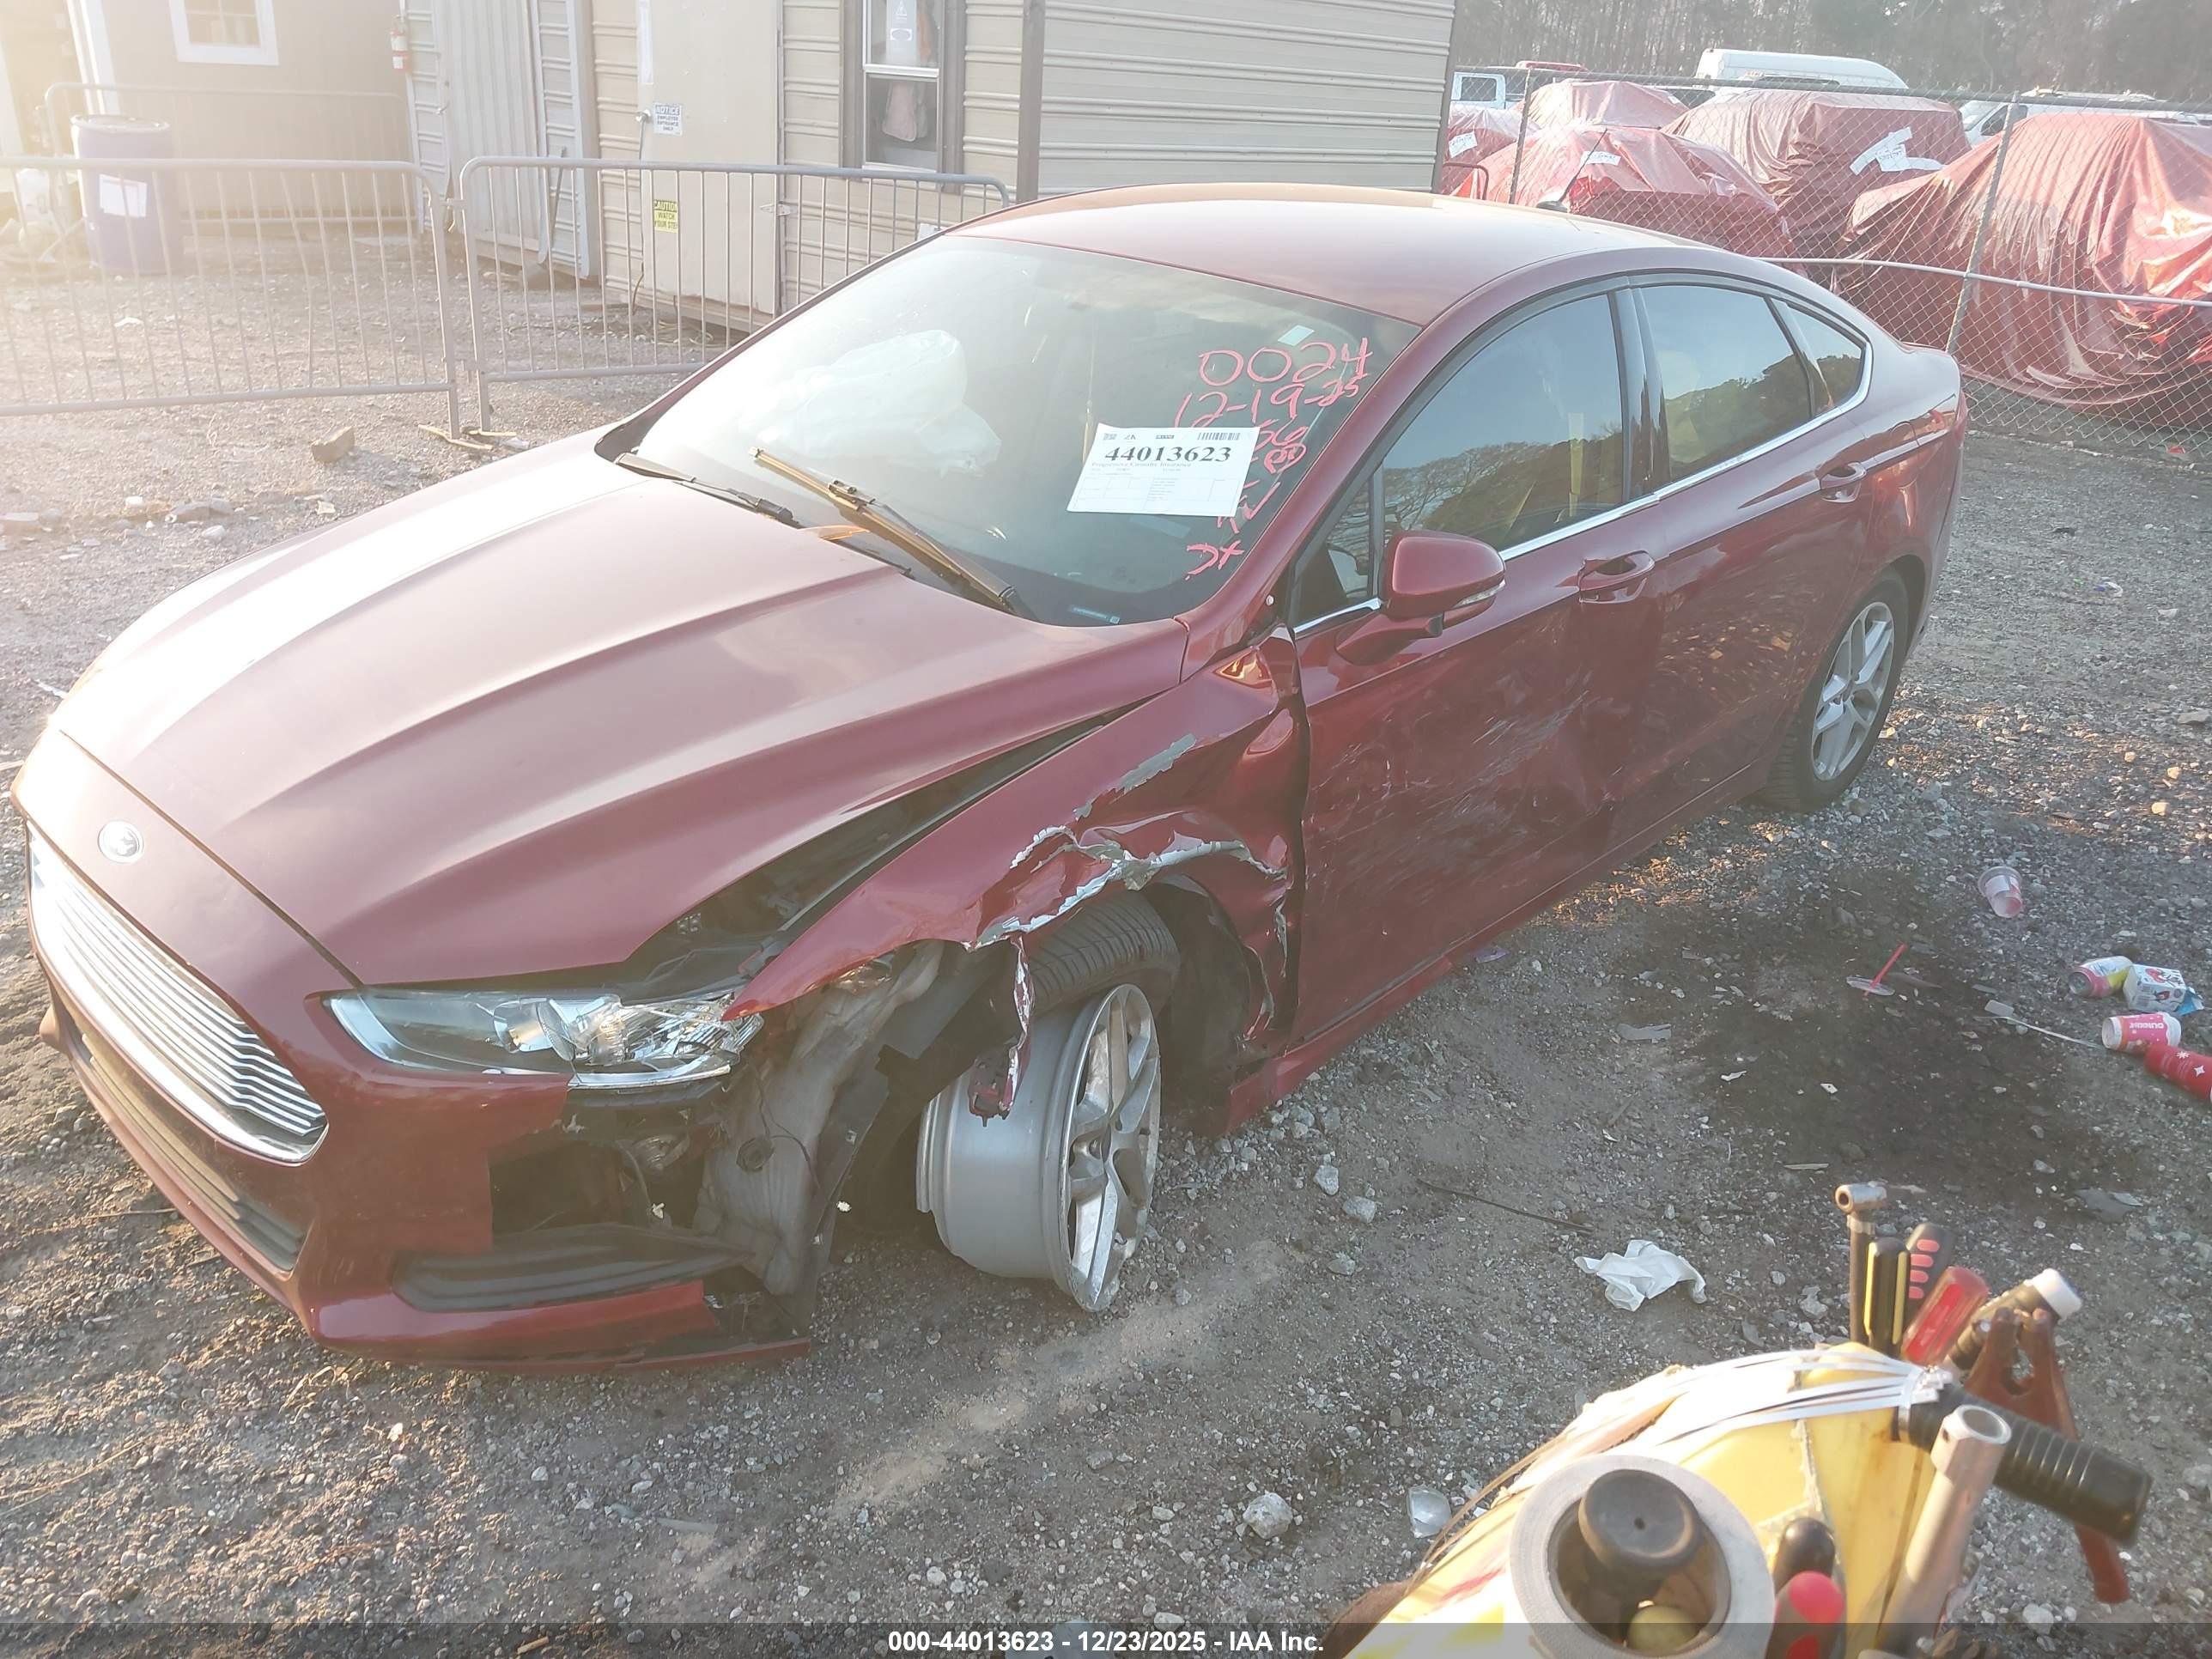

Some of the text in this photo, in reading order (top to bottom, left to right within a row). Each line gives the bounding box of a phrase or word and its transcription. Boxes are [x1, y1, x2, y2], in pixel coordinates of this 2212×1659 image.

[655, 105, 680, 116] NOTICE
[1199, 337, 1373, 386] 0024
[1104, 446, 1231, 462] 44013623
